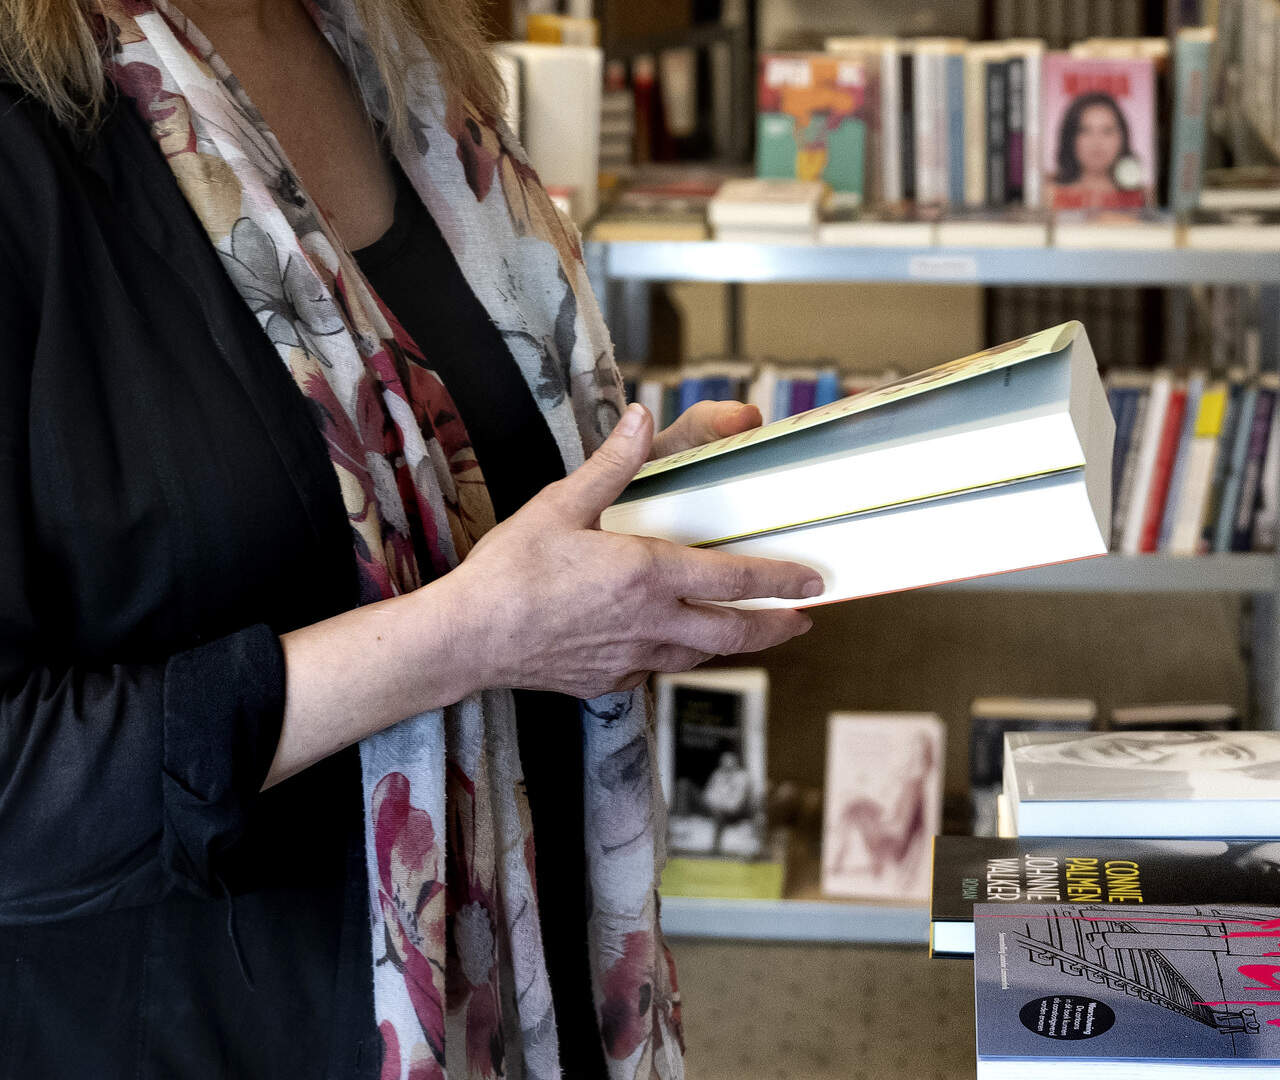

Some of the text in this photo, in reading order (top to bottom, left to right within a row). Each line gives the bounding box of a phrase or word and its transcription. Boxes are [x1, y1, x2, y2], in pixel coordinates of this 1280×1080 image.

[962, 878, 979, 900] ROMAN
[986, 857, 1021, 901] WALKER
[1025, 853, 1061, 901] JOHNNIE
[1065, 857, 1102, 903] PALMEN
[1104, 860, 1144, 903] CONNIE
